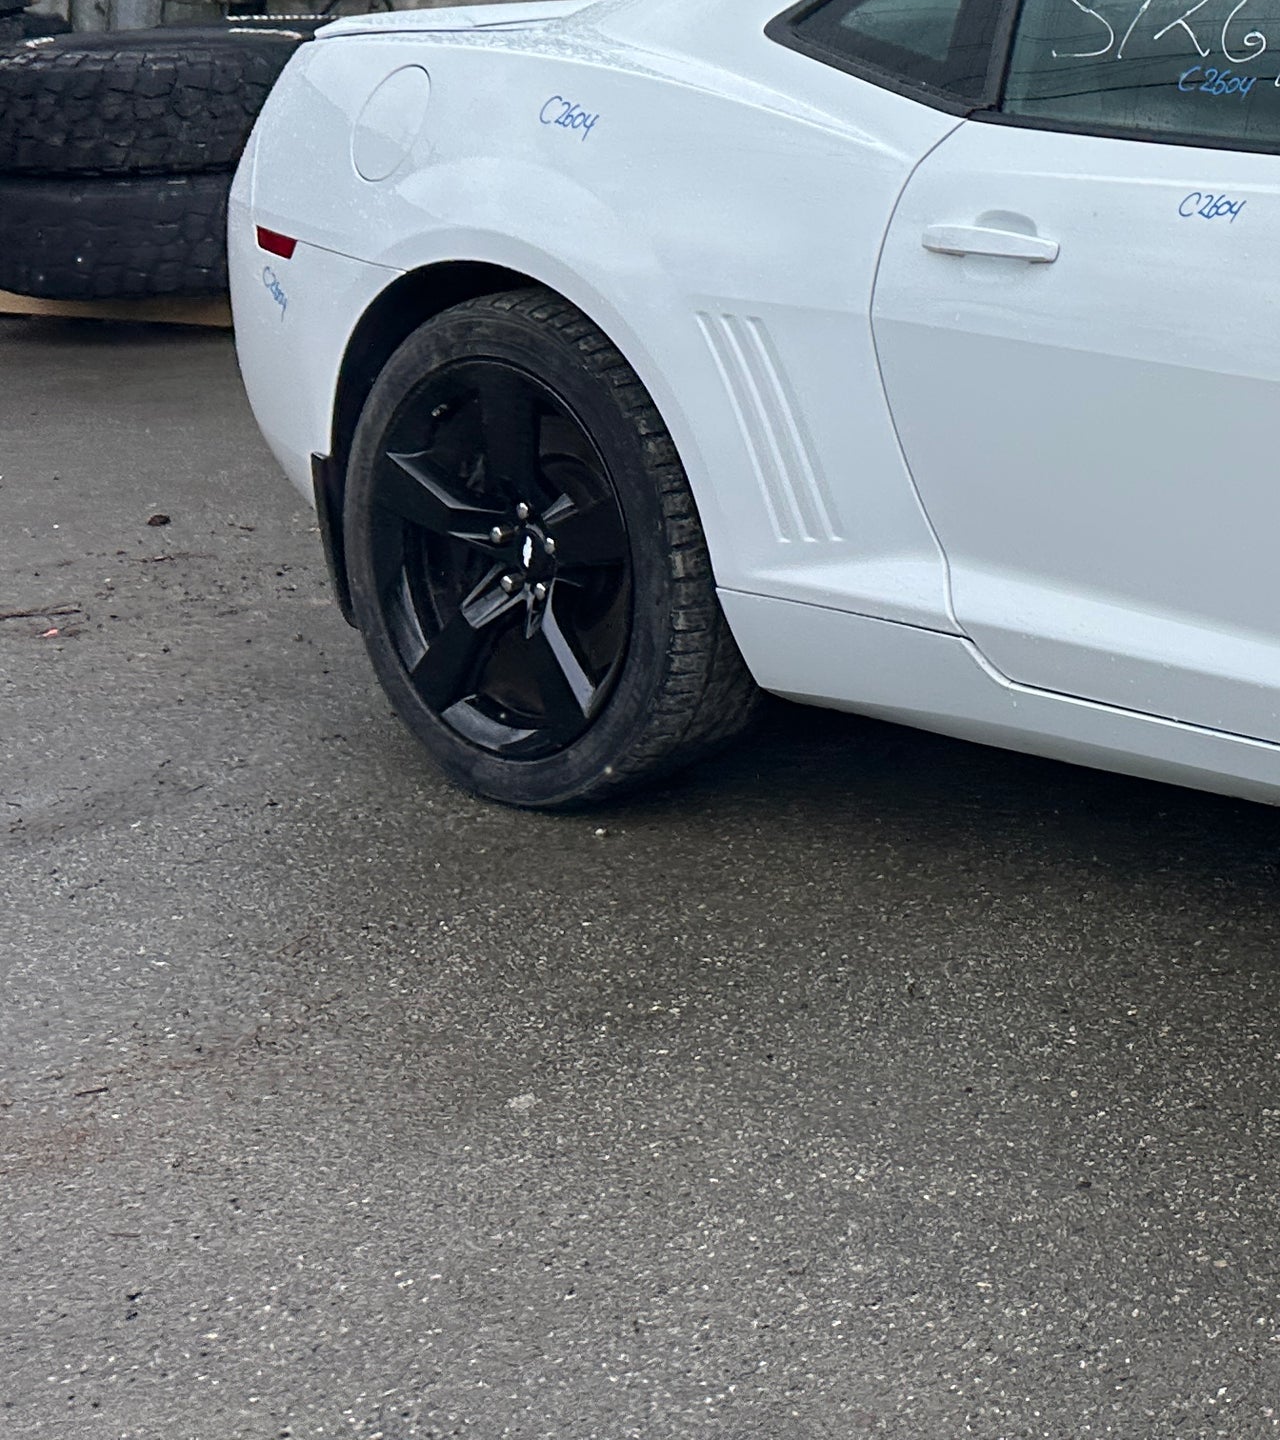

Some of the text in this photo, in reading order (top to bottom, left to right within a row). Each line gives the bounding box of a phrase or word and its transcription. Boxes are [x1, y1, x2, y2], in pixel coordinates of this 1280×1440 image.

[1177, 66, 1257, 102] C2604
[539, 95, 600, 142] C2604
[1178, 192, 1248, 223] C2604
